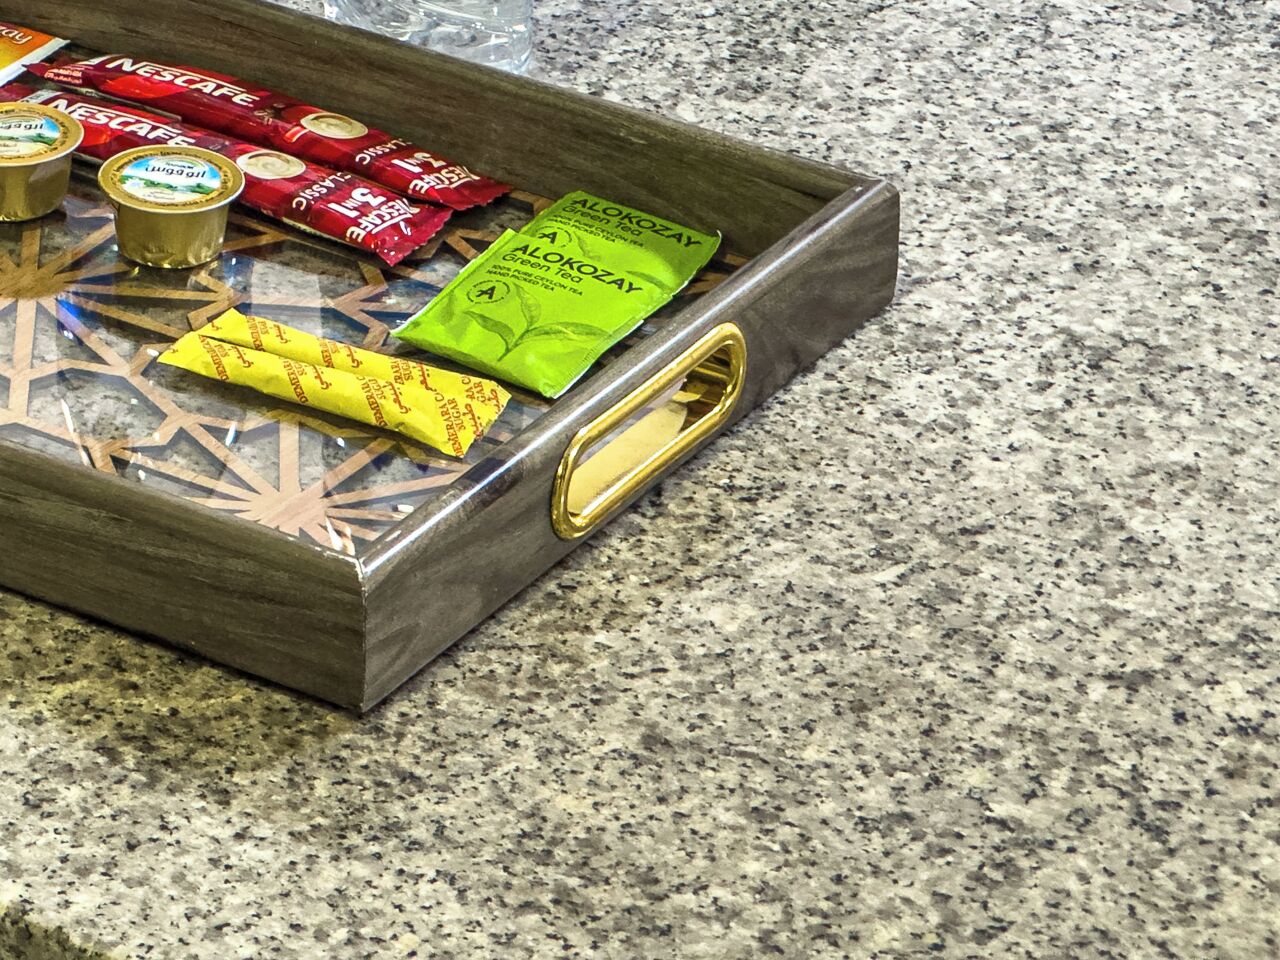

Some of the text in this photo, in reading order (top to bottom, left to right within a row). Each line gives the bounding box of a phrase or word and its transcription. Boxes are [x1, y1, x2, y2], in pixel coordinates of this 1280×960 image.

[562, 205, 643, 237] Green Tea
[570, 197, 703, 248] ALOKOZAY
[486, 269, 511, 280] HAND
[509, 273, 540, 288] PICKED
[540, 283, 556, 292] TEA
[502, 253, 584, 284] Green Tea
[511, 243, 643, 294] ALOKOZAY
[513, 268, 534, 279] PURE
[534, 274, 569, 290] CEYLON
[568, 286, 584, 297] TEA
[447, 397, 466, 432] SUGAR
